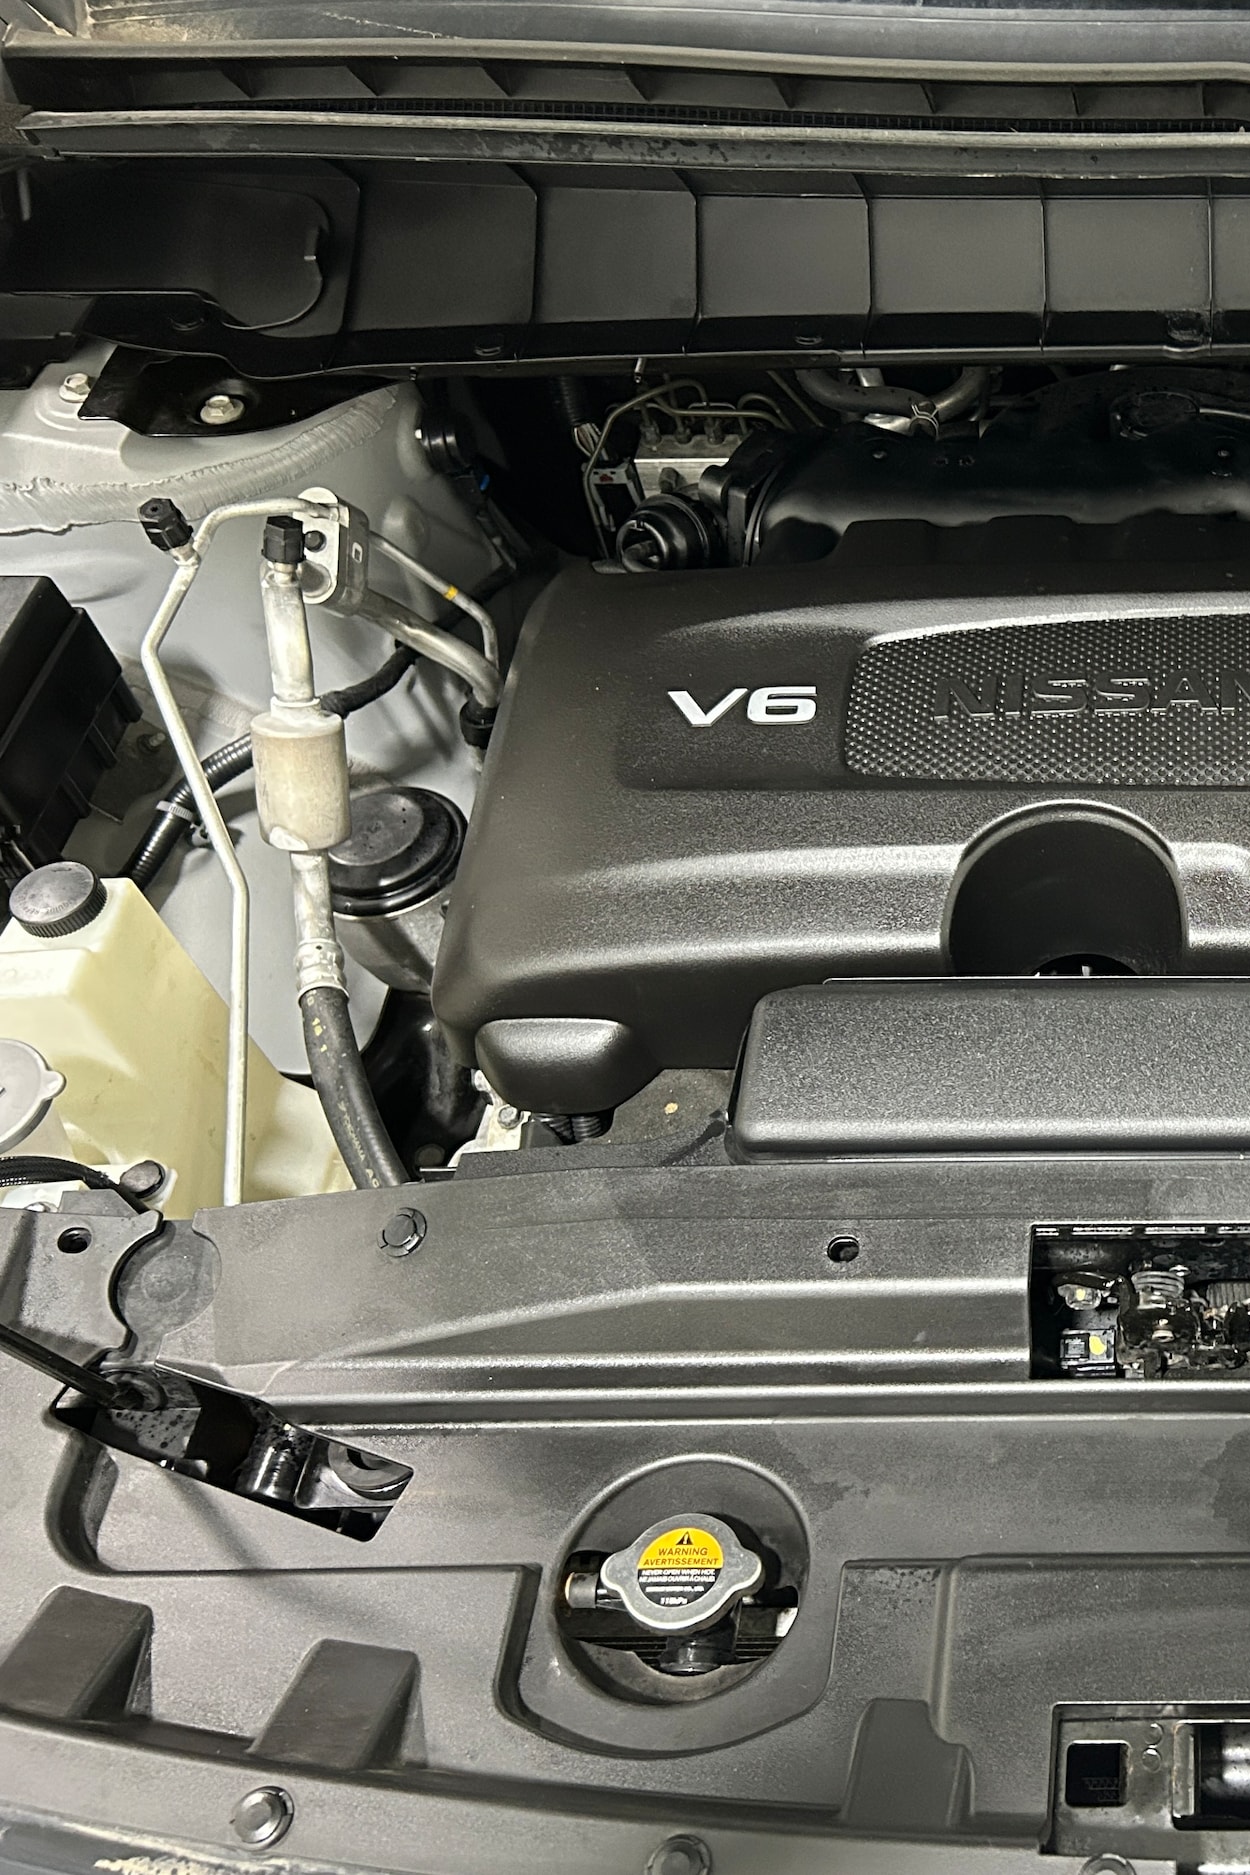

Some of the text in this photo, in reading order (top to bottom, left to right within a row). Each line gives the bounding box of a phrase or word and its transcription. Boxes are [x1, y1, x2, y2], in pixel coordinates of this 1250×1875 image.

[668, 686, 817, 728] V6
[658, 1547, 709, 1556] WARNING
[643, 1558, 719, 1566] AVERTISSEMENT
